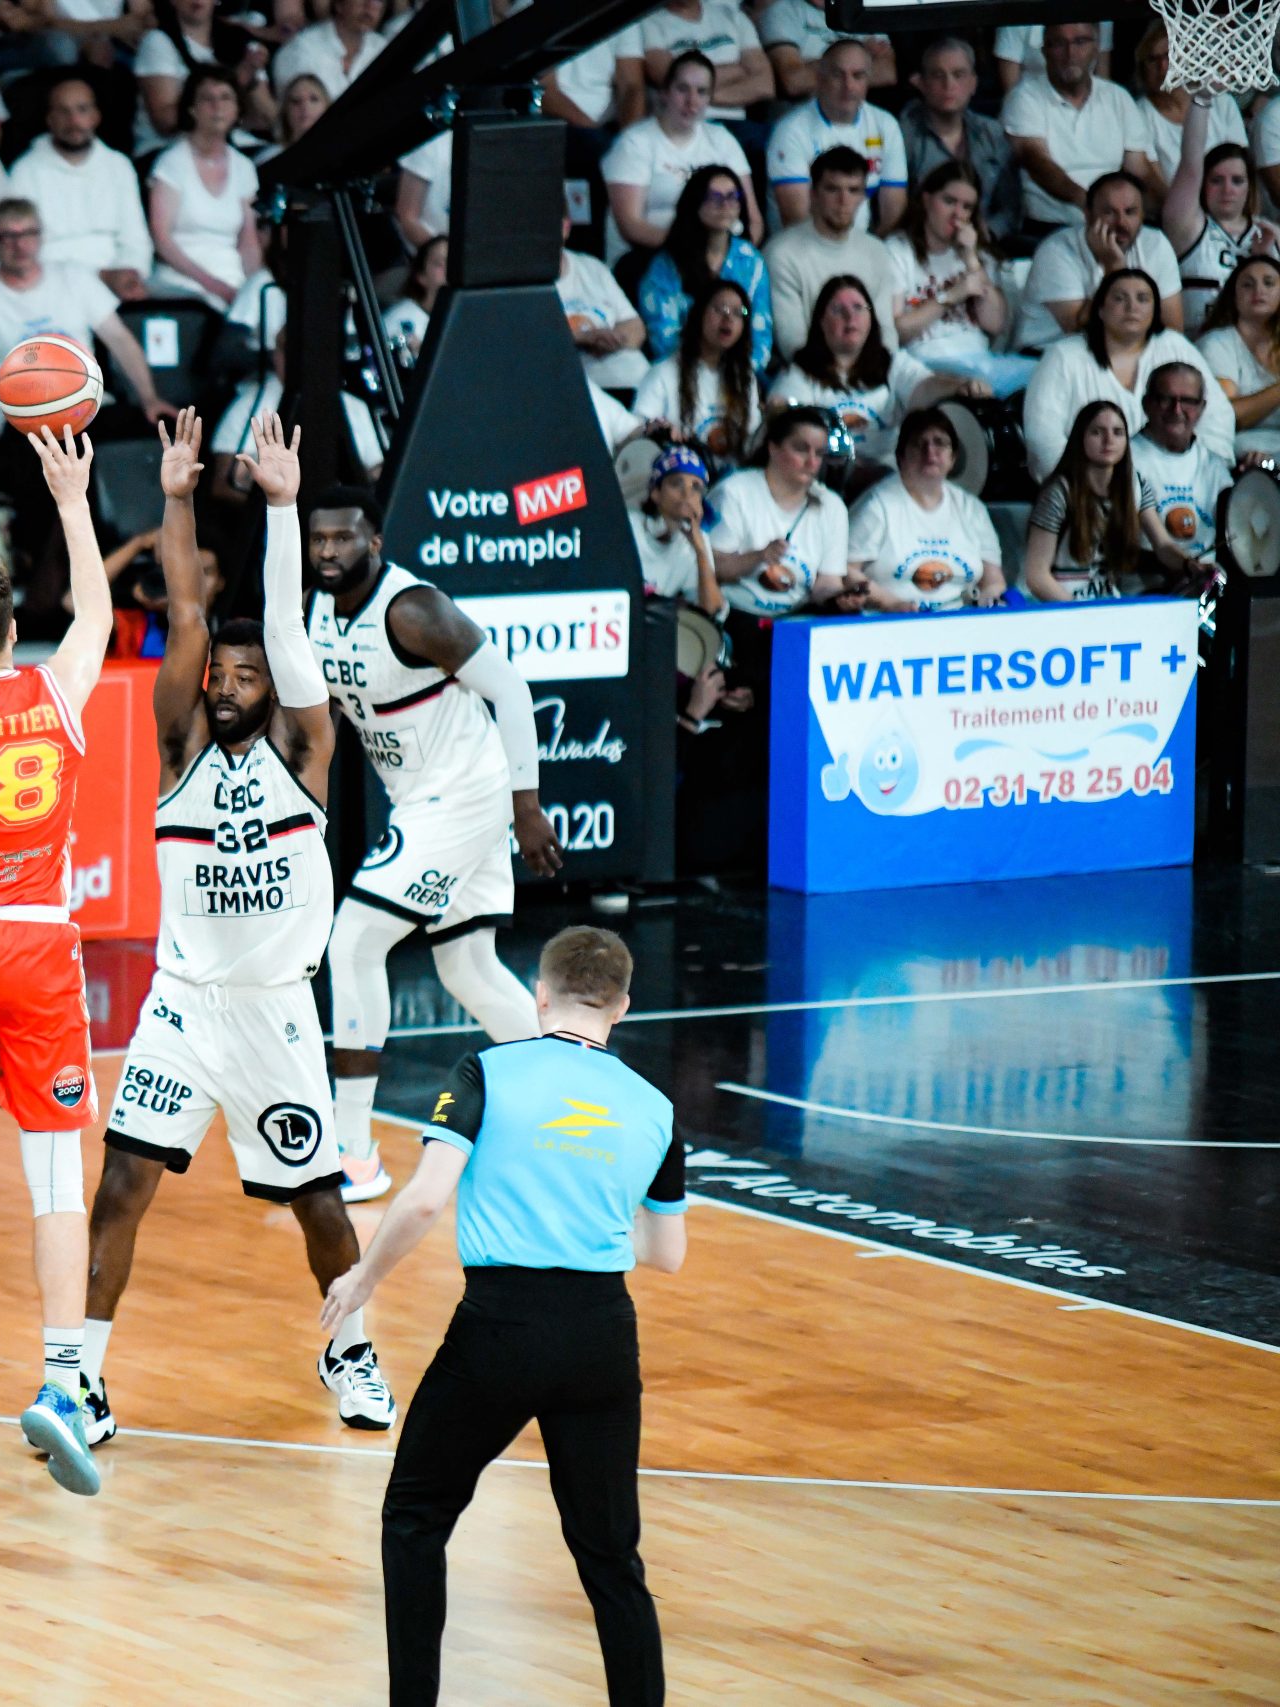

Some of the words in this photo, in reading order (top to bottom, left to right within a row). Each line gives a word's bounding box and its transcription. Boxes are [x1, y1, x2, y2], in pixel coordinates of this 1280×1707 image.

[428, 489, 509, 519] Votre
[519, 475, 582, 518] MVP
[421, 534, 459, 566] de
[466, 526, 581, 567] l'emploi
[322, 658, 368, 689] CBC
[822, 642, 1142, 702] WATERSOFT
[346, 692, 366, 721] 3
[950, 703, 1066, 729] Traitement
[1073, 701, 1099, 721] de
[1107, 698, 1158, 719] l'eau
[214, 778, 265, 814] CBC
[944, 777, 981, 804] 02
[993, 774, 1025, 802] 31
[1040, 770, 1076, 799] 78
[1087, 767, 1123, 795] 25
[1134, 763, 1171, 792] 04
[217, 818, 268, 854] 32
[195, 856, 291, 889] BRAVIS
[207, 886, 284, 914] IMMO
[55, 1074, 84, 1089] SPORT
[57, 1084, 82, 1097] 2000
[124, 1065, 193, 1101] EQUIP
[533, 1137, 556, 1150] LA
[560, 1142, 617, 1165] POSTE
[699, 1174, 1127, 1279] Automobiles
